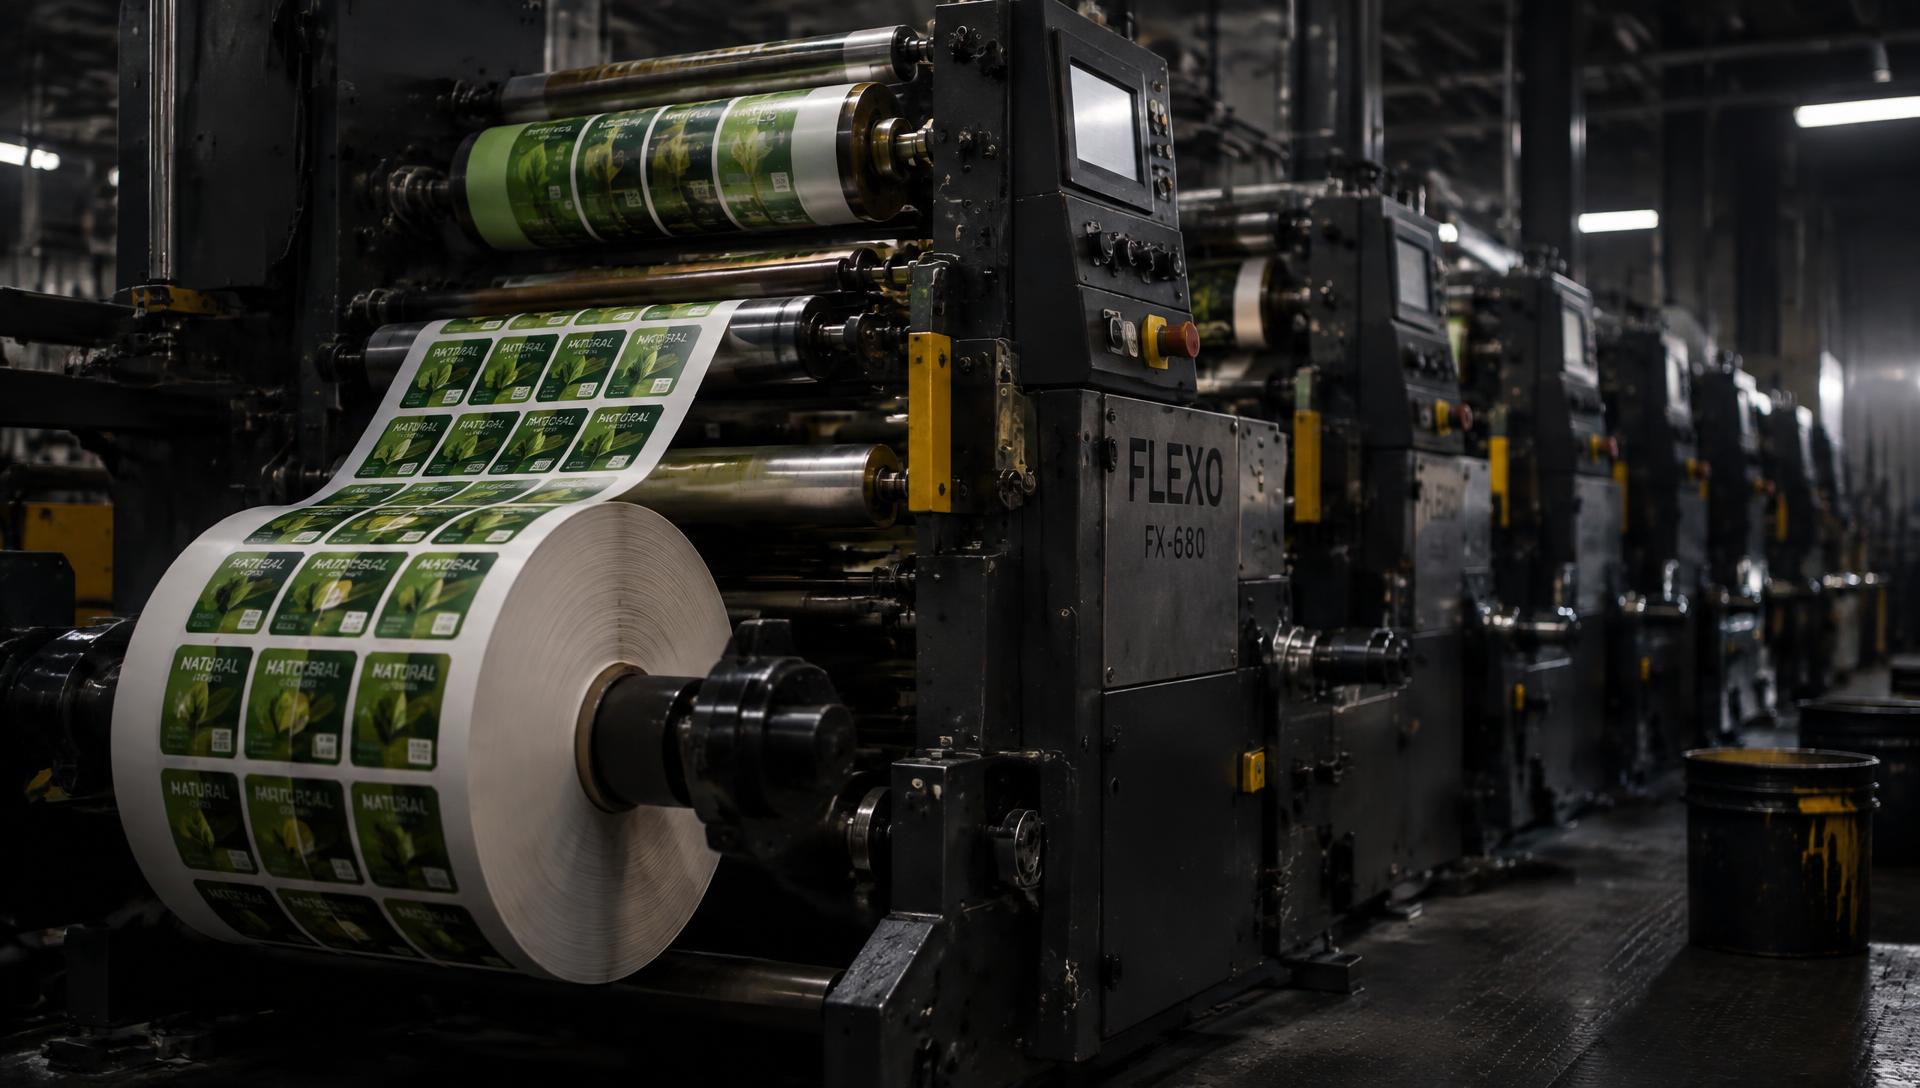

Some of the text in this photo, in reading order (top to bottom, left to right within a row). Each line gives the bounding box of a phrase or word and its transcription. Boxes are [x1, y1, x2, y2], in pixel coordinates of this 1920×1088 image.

[1129, 437, 1224, 507] FLEXO
[1145, 525, 1205, 559] FX-680
[180, 656, 239, 674] NATURAL
[171, 781, 230, 801] NATURAL
